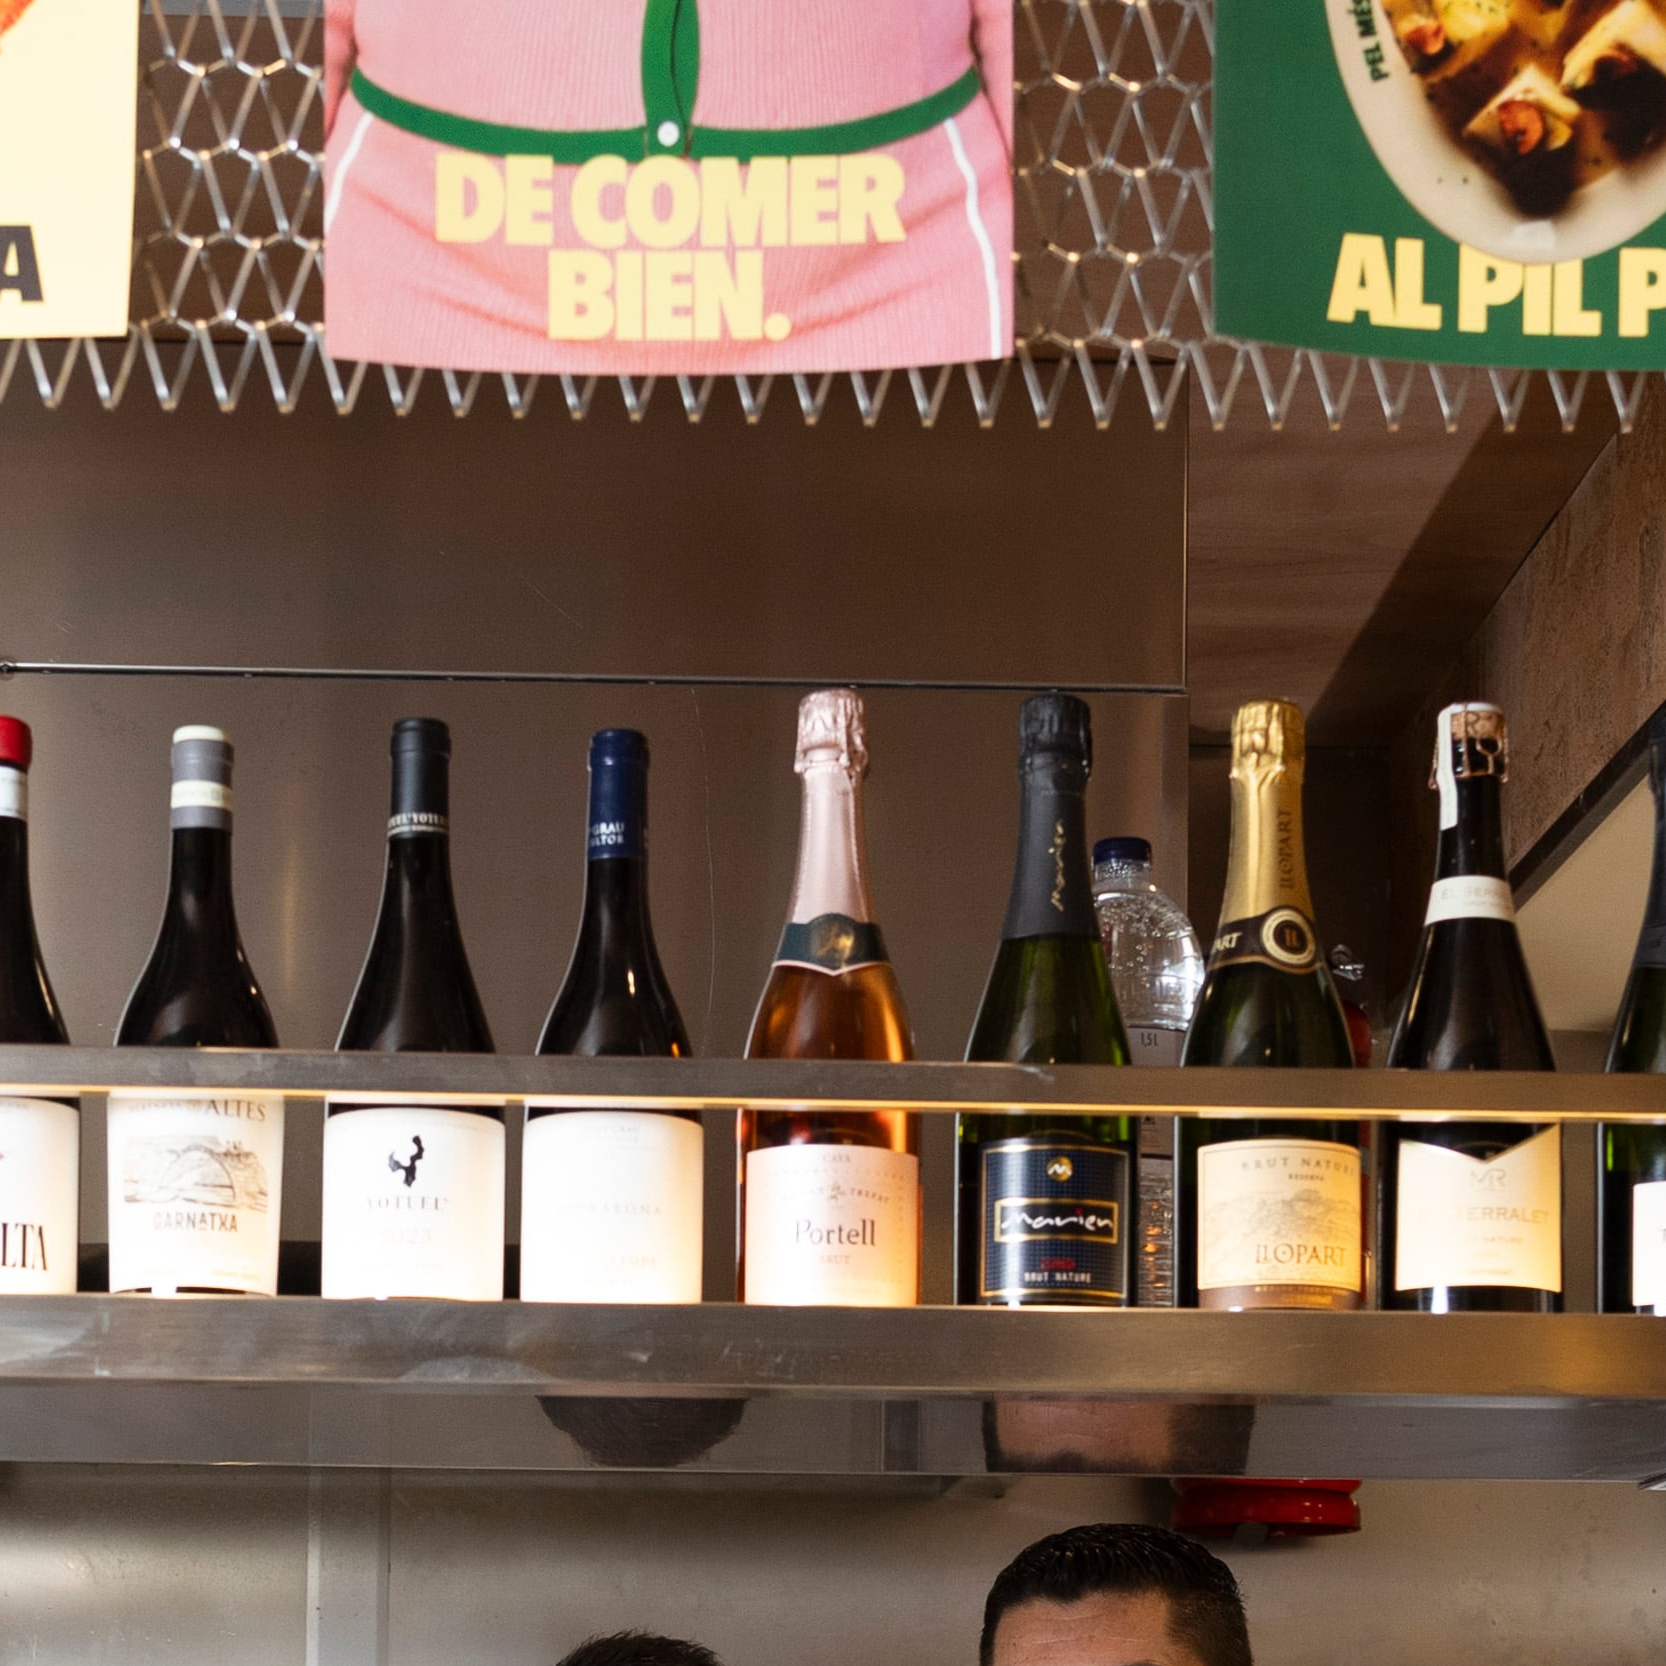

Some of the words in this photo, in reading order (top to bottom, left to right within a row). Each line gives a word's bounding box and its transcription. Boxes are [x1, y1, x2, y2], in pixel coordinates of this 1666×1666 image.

[1363, 41, 1389, 83] PEL
[435, 154, 554, 245] DE
[570, 154, 906, 248] COMER
[547, 249, 792, 342] BIEN.
[1326, 232, 1442, 330] AL
[1458, 243, 1602, 337] PIL
[795, 1218, 877, 1247] Portell
[1024, 1271, 1049, 1283] BRUT
[1055, 1271, 1091, 1284] NATURE
